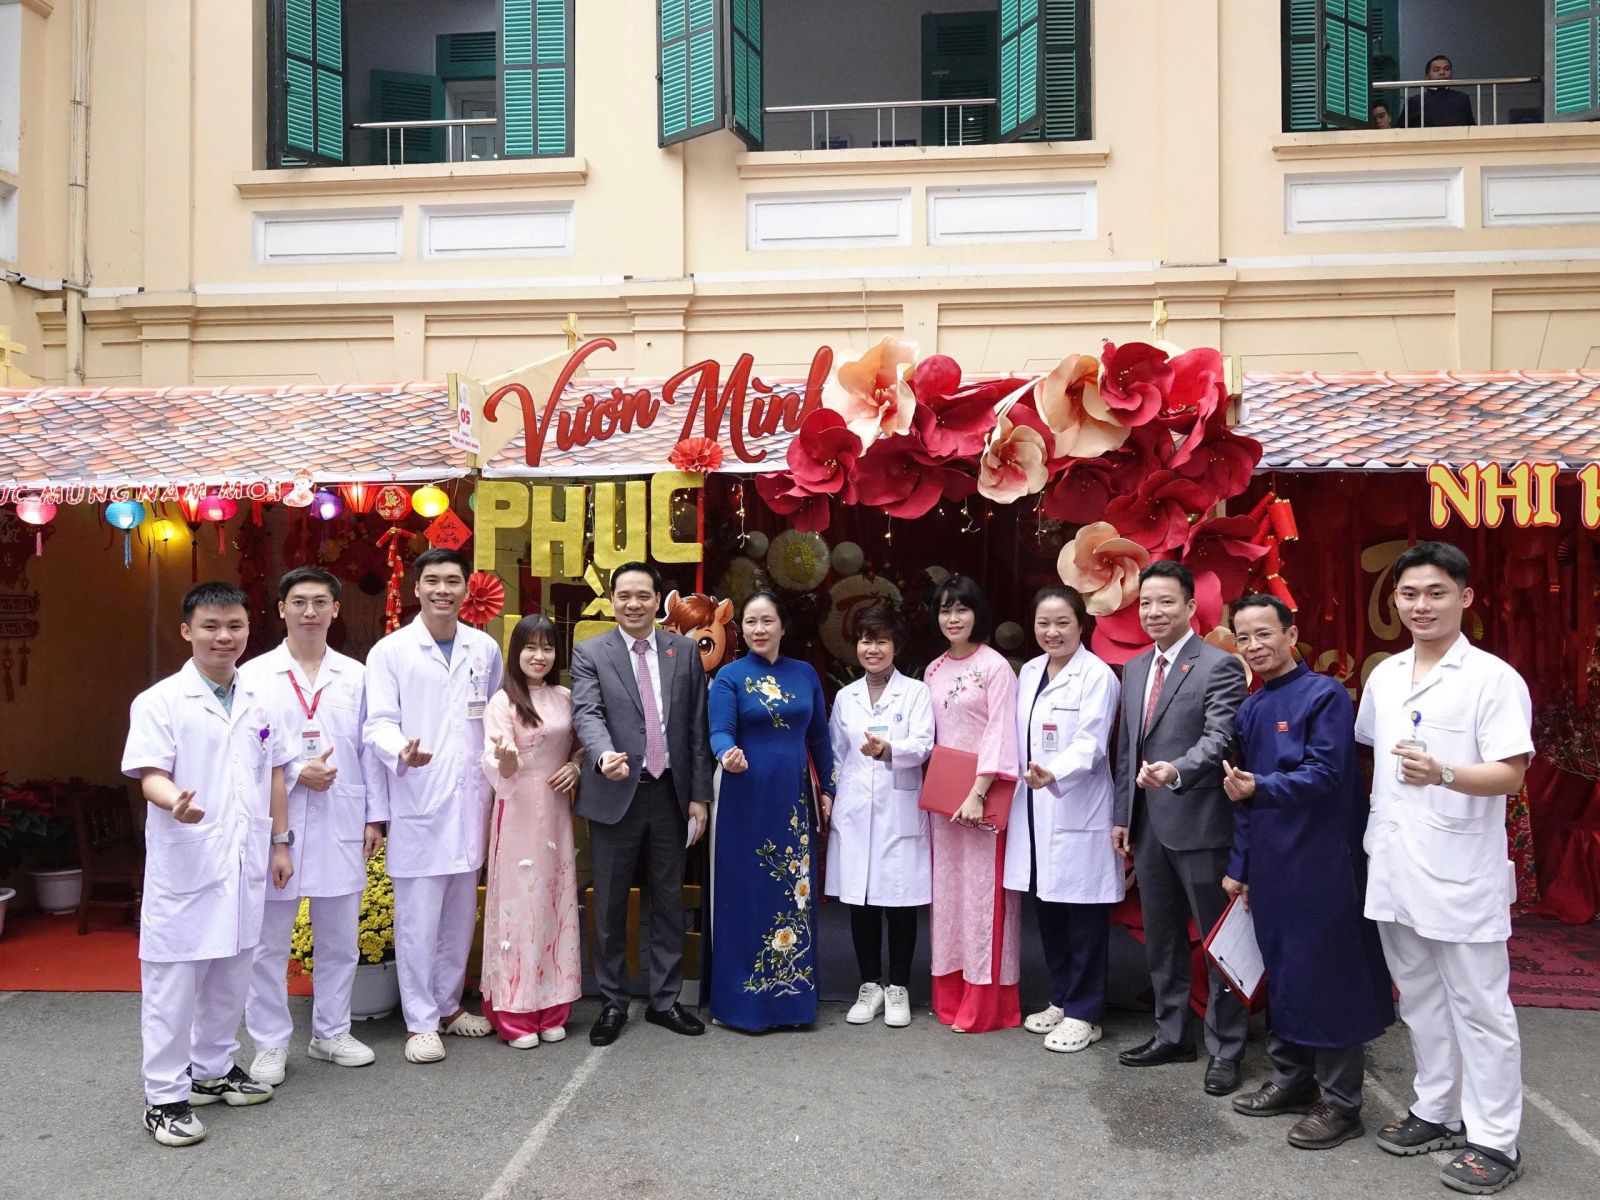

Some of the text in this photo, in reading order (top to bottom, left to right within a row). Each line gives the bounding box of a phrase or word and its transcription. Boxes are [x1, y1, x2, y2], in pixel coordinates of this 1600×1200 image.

[460, 407, 471, 425] 05
[483, 337, 660, 467] Vươn
[1427, 461, 1561, 529] NHI
